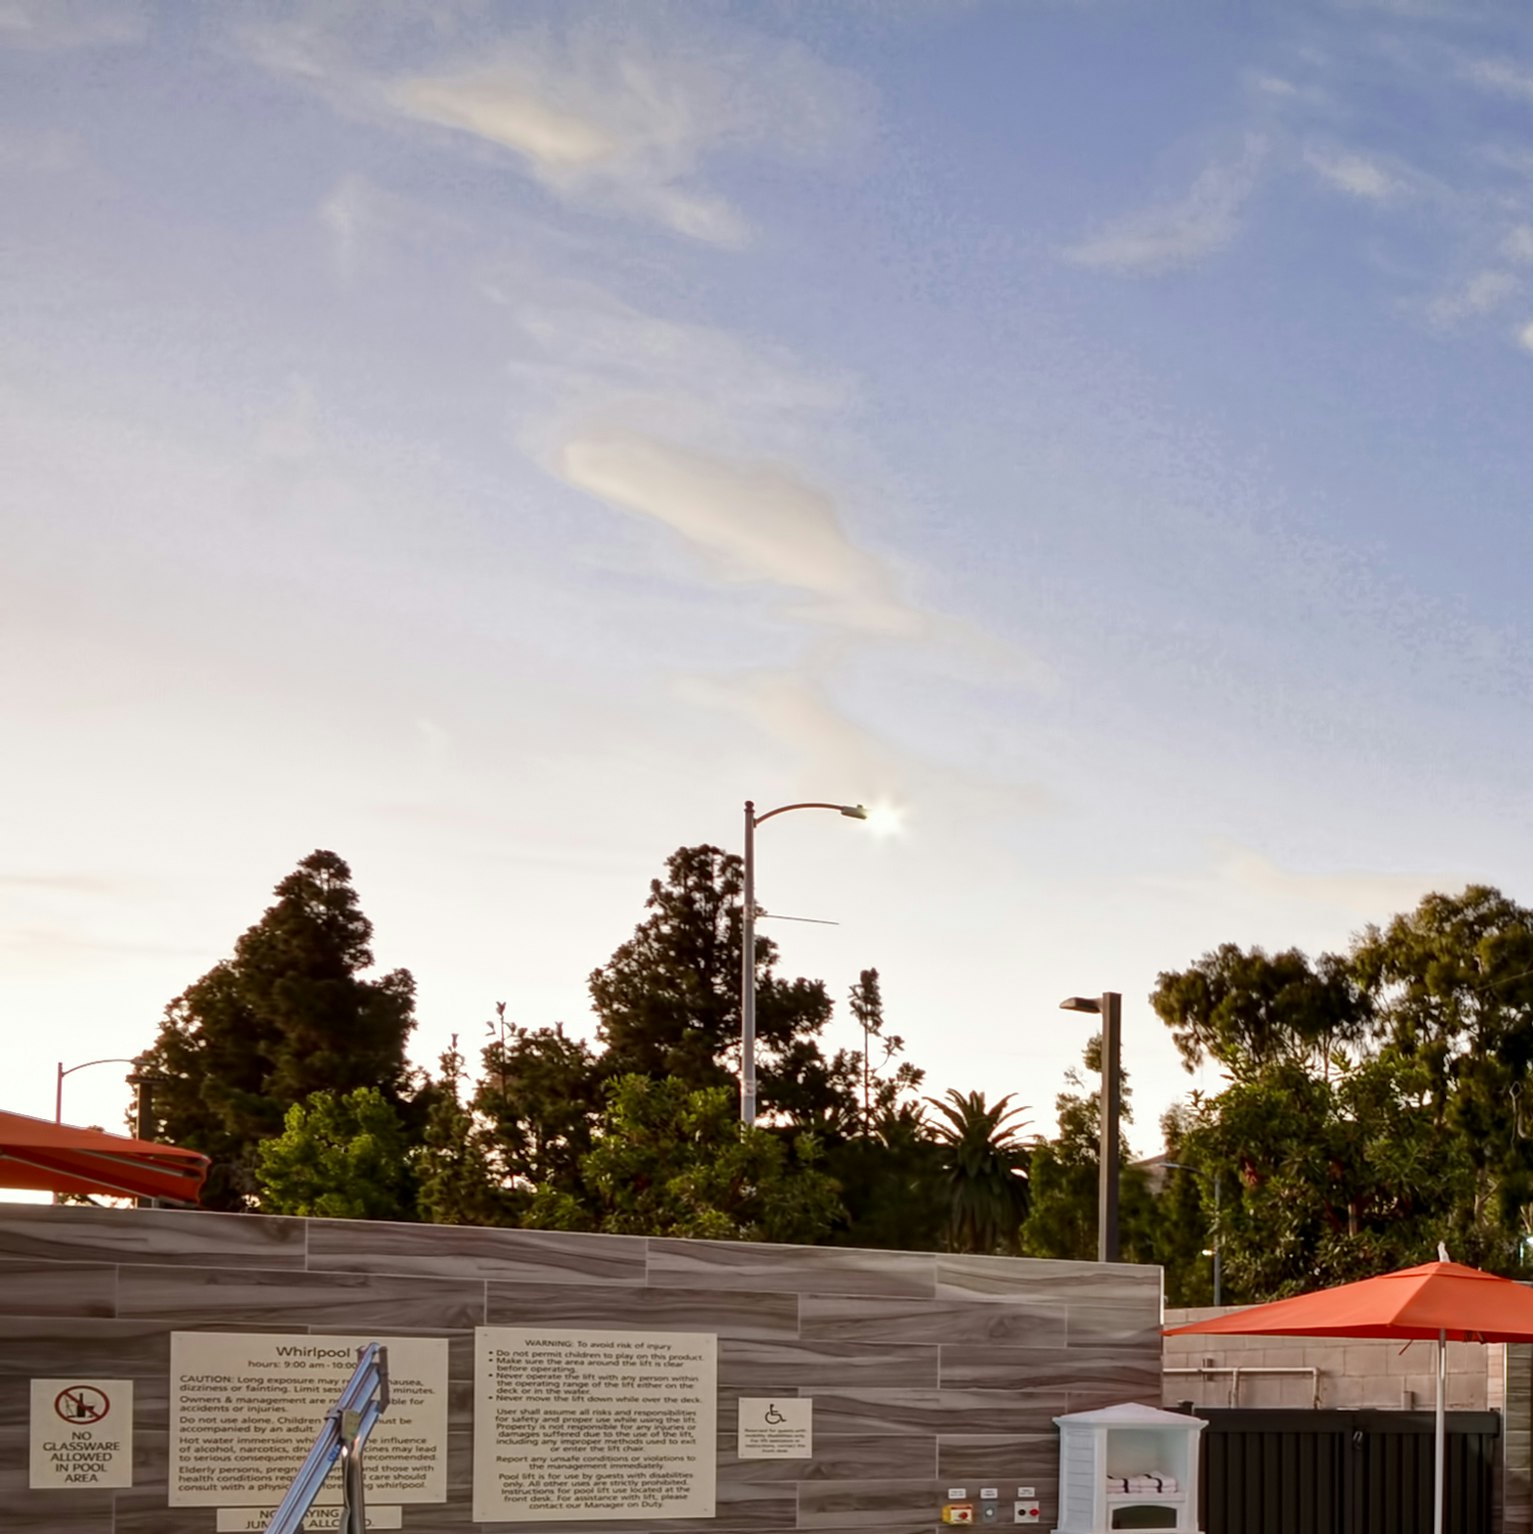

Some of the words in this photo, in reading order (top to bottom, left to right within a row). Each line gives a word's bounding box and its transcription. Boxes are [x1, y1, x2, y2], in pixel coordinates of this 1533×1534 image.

[276, 1346, 351, 1360] Whirlpool
[247, 1360, 281, 1368] hours:
[283, 1360, 307, 1368] 9:00
[180, 1375, 235, 1383] CAUTION:
[237, 1376, 264, 1385] Long
[267, 1378, 315, 1386] exposure
[179, 1384, 228, 1392] dizziness
[246, 1385, 288, 1394] fainting.
[293, 1385, 320, 1393] Limit
[235, 1396, 307, 1405] management
[180, 1404, 230, 1412] accidents
[247, 1405, 287, 1414] injuries.
[198, 1416, 217, 1424] not
[179, 1425, 252, 1434] accompanied
[253, 1425, 267, 1434] by
[72, 1432, 92, 1440] NO
[43, 1442, 120, 1451] GLASSWARE
[194, 1445, 236, 1454] alcohol,
[239, 1445, 290, 1454] narcotics,
[50, 1452, 113, 1462] ALLOWED
[179, 1454, 192, 1462] to
[193, 1454, 232, 1462] serious
[56, 1463, 69, 1472] IN
[73, 1463, 108, 1472] POOL
[178, 1466, 216, 1475] Elderly
[218, 1467, 263, 1475] persons,
[65, 1474, 98, 1483] AREA
[216, 1474, 273, 1482] conditions
[178, 1483, 218, 1491] consult
[376, 1481, 425, 1490] whirlpool.
